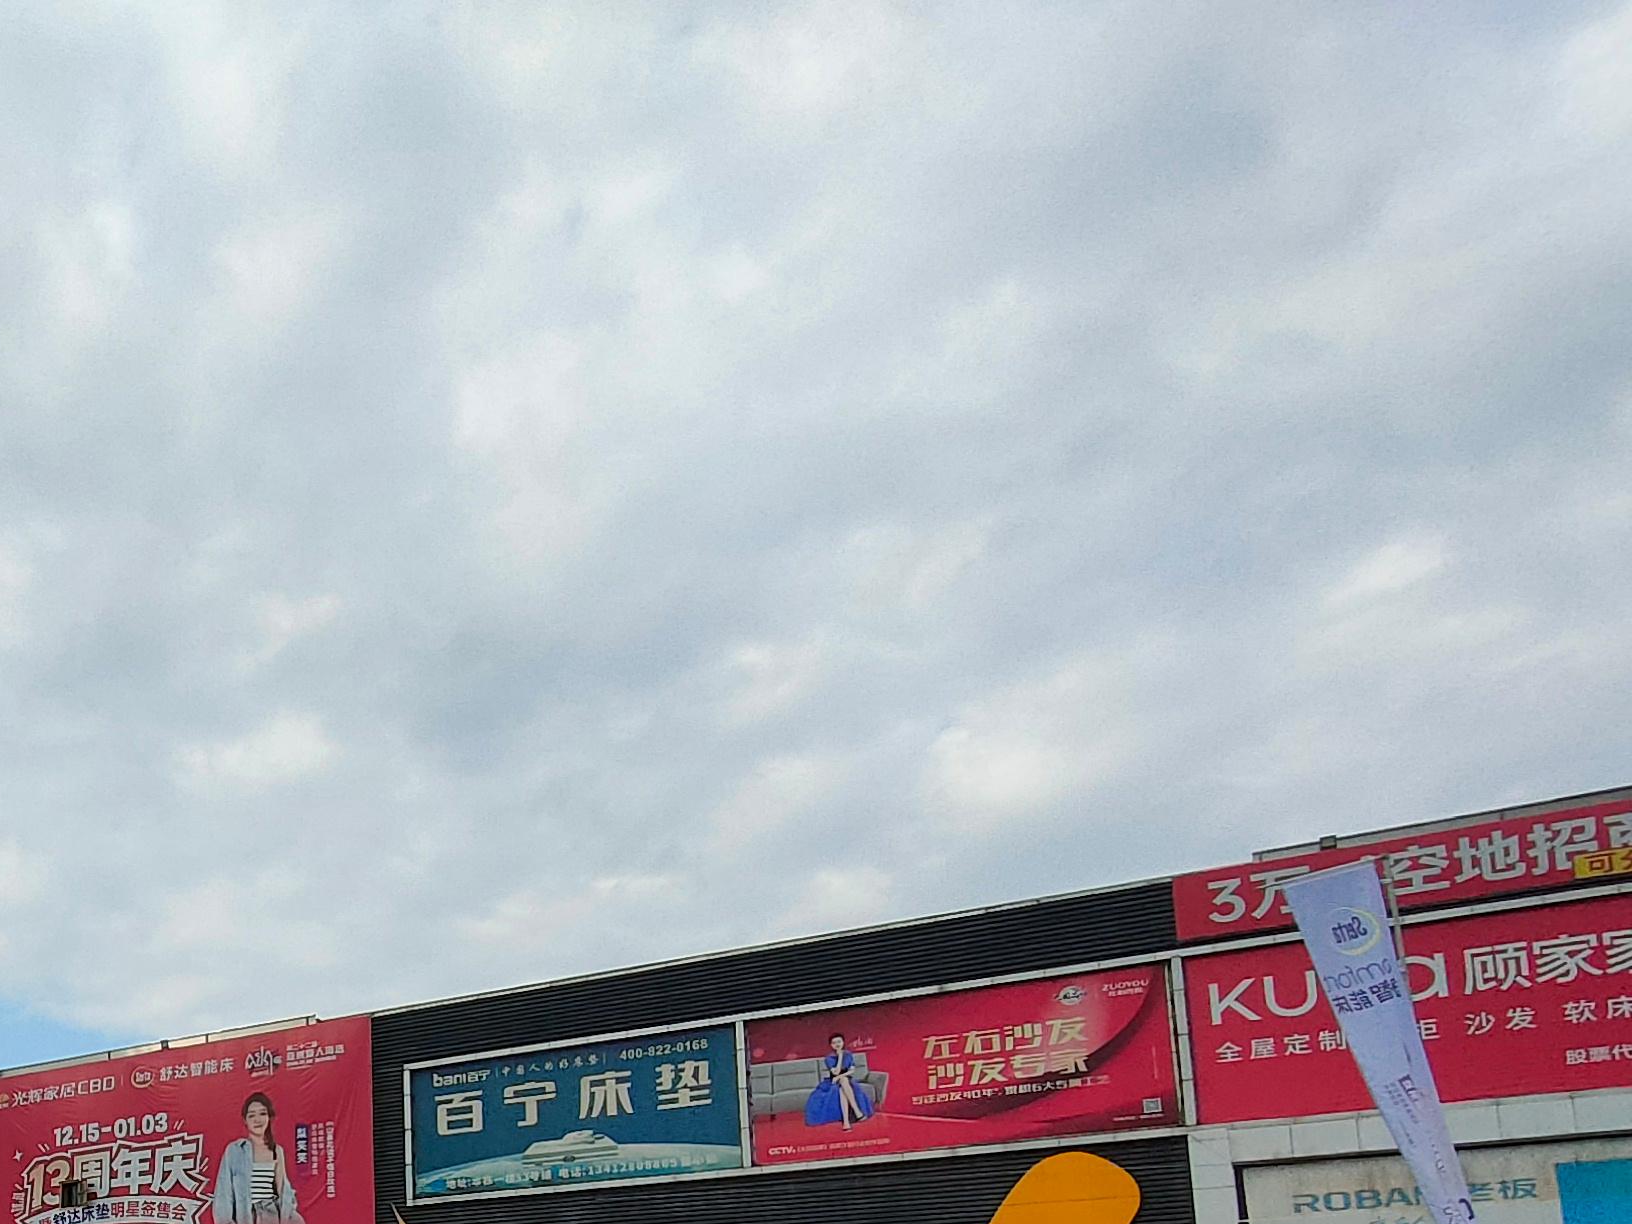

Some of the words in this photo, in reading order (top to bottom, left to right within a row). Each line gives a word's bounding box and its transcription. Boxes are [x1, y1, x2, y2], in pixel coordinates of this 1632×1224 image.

[1206, 812, 1632, 924] 3万空地招
[1210, 952, 1452, 1026] KUa
[922, 1017, 1088, 1061] 左右沙发
[1464, 1006, 1537, 1036] 沙发
[435, 1060, 713, 1137] 百宁床垫
[927, 1049, 1090, 1090] 沙发专家
